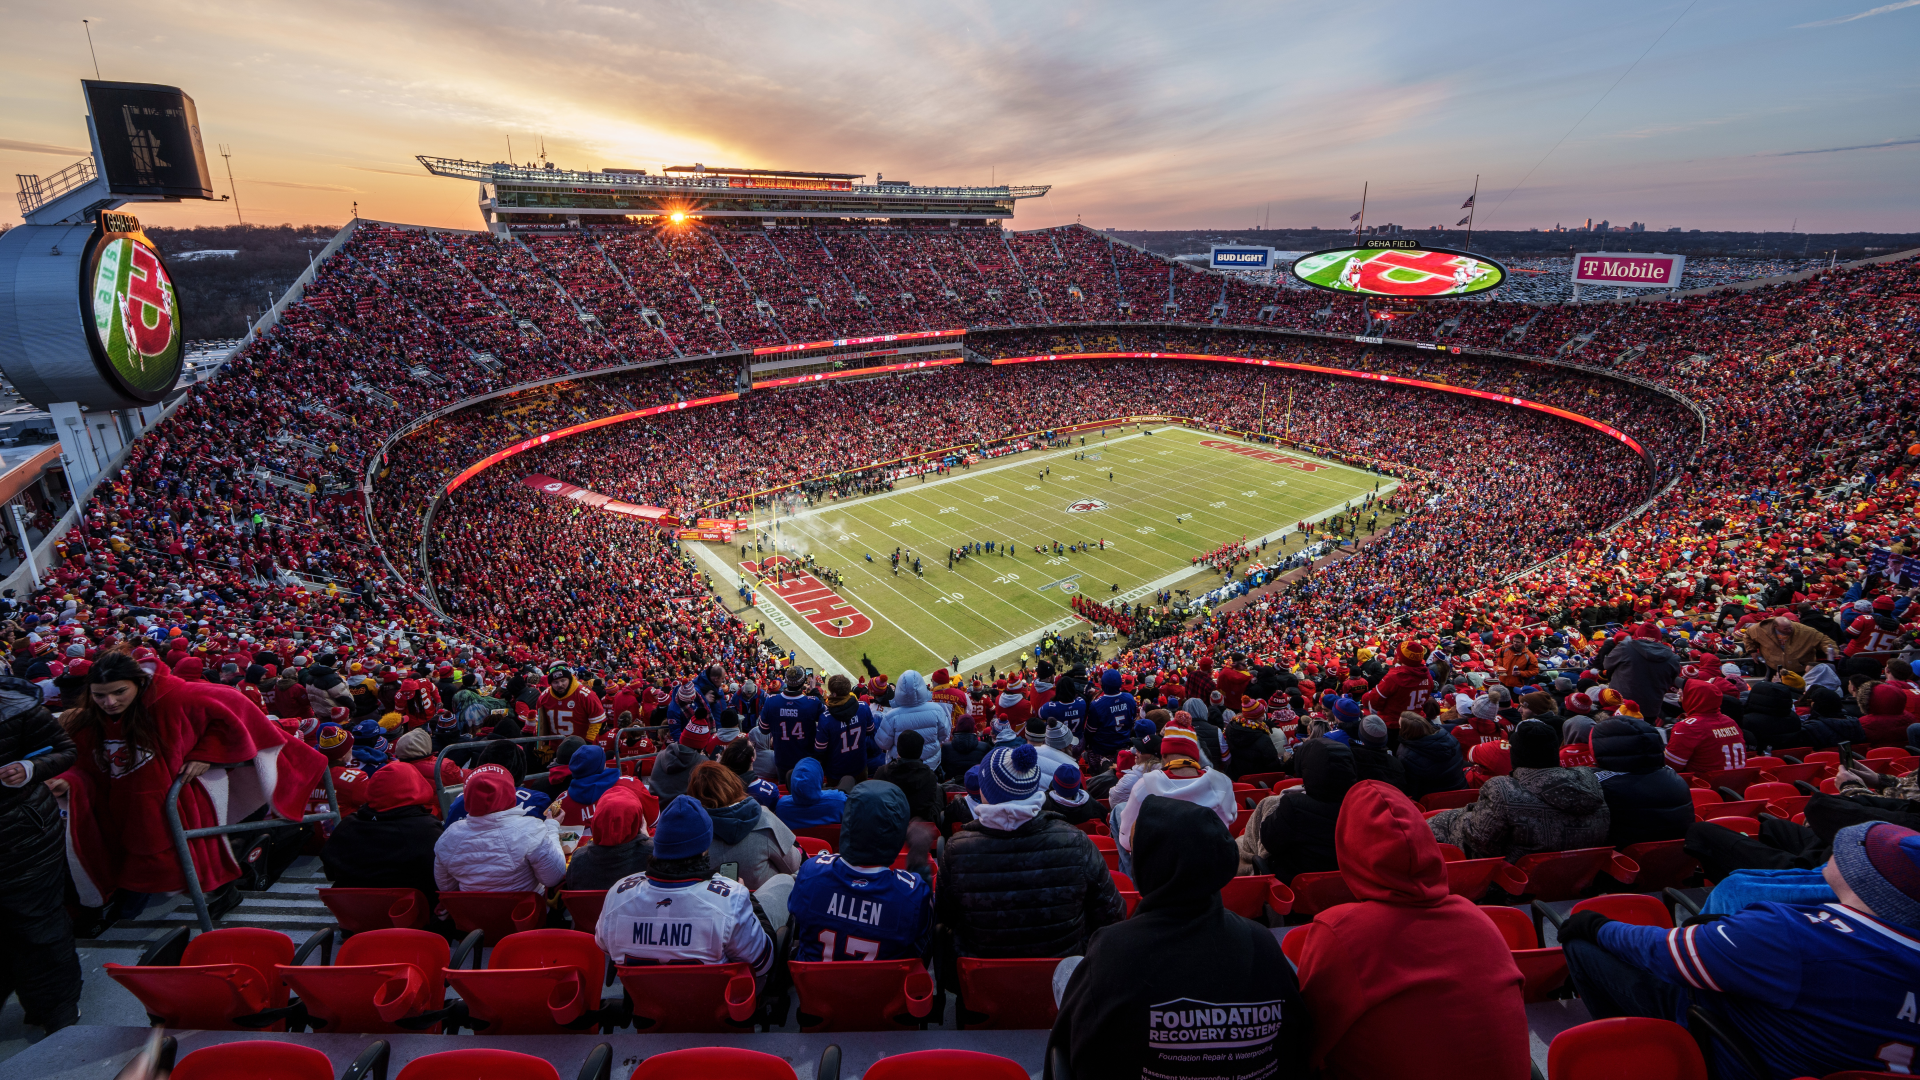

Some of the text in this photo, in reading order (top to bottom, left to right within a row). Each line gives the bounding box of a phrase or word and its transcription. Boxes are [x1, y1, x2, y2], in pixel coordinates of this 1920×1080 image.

[755, 178, 776, 188] SUPER
[776, 179, 795, 189] BOWL
[795, 180, 830, 190] CHAMPIONS
[107, 213, 125, 233] GEHA
[1367, 240, 1416, 248] GEHA FIELD
[1217, 253, 1264, 263] BUD LIGHT
[1600, 261, 1665, 279] Mobile
[1358, 336, 1379, 344] GEHA
[826, 354, 846, 363] GEHA
[846, 352, 865, 360] FIELD
[1198, 439, 1333, 473] CHIEFS
[1863, 631, 1897, 653] 15
[578, 685, 592, 698] 15
[950, 694, 960, 703] CITY
[1406, 689, 1429, 711] 15
[779, 707, 799, 718] DIGGS
[1064, 709, 1079, 717] ALLEN
[1109, 702, 1128, 715] TAYLOR
[546, 708, 575, 736] 15
[1114, 714, 1126, 732] 5
[779, 721, 806, 742] 14
[839, 725, 863, 754] 17
[1711, 726, 1740, 739] PACHECO
[1721, 742, 1746, 771] 10
[488, 765, 506, 776] CITY
[759, 779, 775, 797] 17
[826, 891, 883, 927] ALLEN
[632, 921, 693, 948] MILANO
[817, 927, 882, 962] 17
[1149, 1003, 1283, 1029] FOUNDATION
[1149, 1022, 1283, 1042] RECOVERY SYSTEMS
[1158, 1044, 1274, 1063] Foundation Repair & Waterproofing
[1142, 1066, 1179, 1080] Basement
